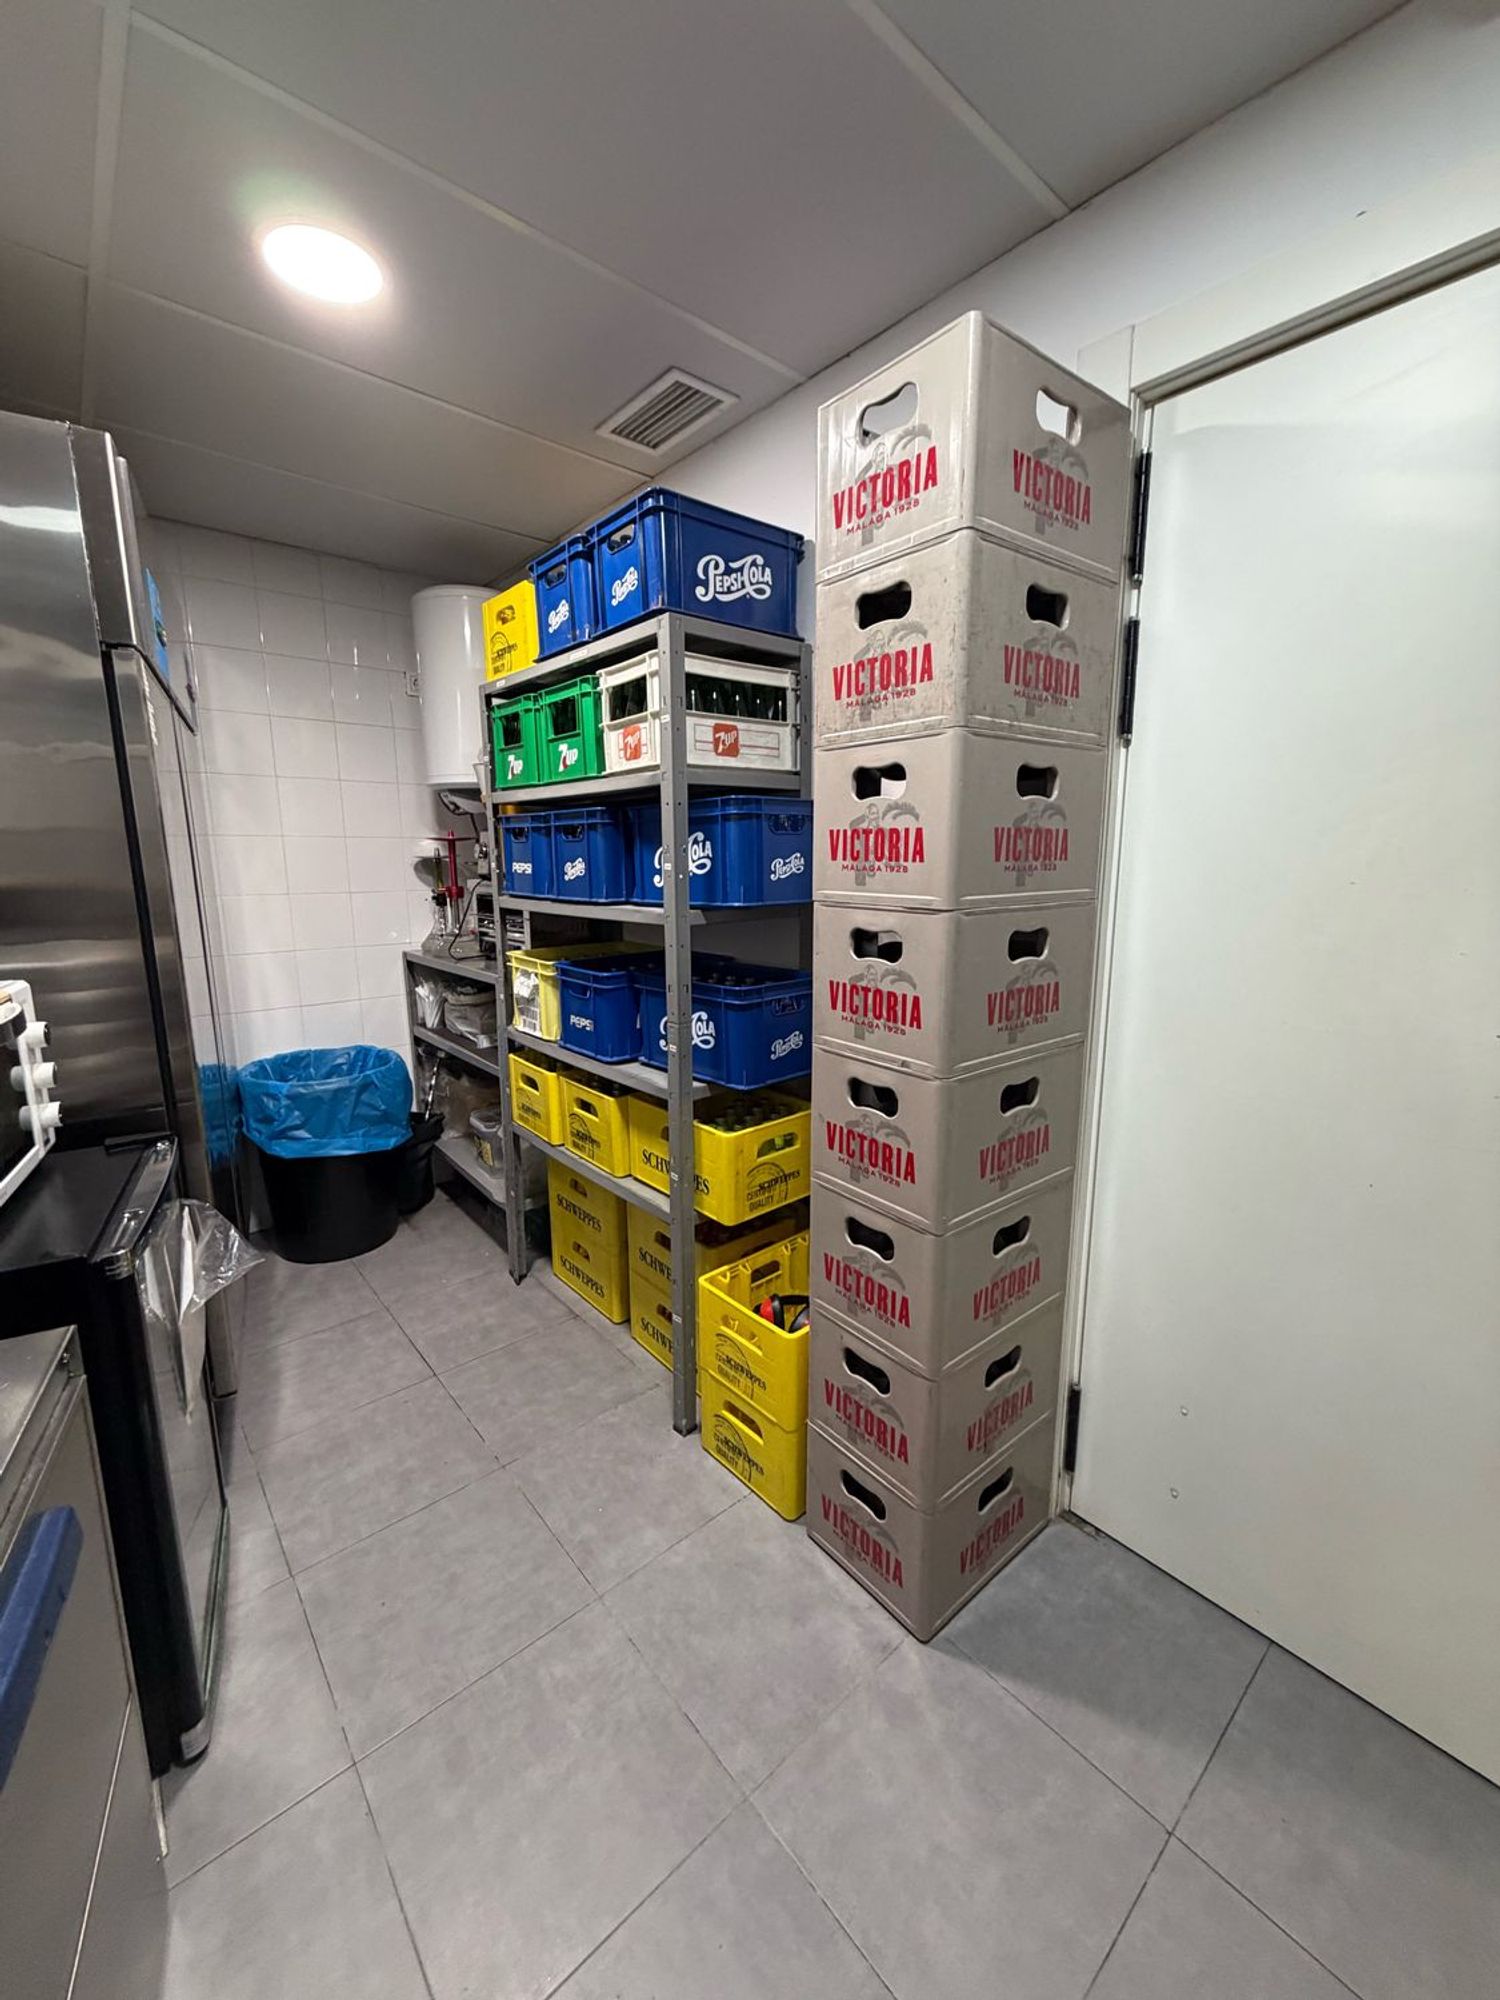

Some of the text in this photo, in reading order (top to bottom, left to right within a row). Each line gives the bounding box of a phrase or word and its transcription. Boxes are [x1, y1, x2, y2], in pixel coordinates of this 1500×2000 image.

[832, 445, 938, 530] VICTORIA
[1013, 448, 1090, 525] VICTORIA
[832, 642, 934, 701] VICTORIA
[1003, 645, 1080, 699] VICTORIA
[829, 827, 925, 863] VICTORIA
[994, 827, 1068, 863] VICTORIA
[829, 979, 922, 1030] VICTORIA
[987, 981, 1060, 1026] VICTORIA
[826, 1120, 916, 1185] VICTORIA
[979, 1124, 1050, 1180] VICTORIA
[556, 1194, 602, 1233] SCHWEPPES
[559, 1254, 605, 1299] SCHWEPPES
[824, 1252, 911, 1329] VICTORIA
[973, 1257, 1041, 1321] VICTORIA
[824, 1378, 909, 1465] VICTORIA
[967, 1380, 1034, 1452] VICTORIA
[821, 1493, 903, 1588] VICTORIA
[960, 1496, 1024, 1574] VICTORIA
